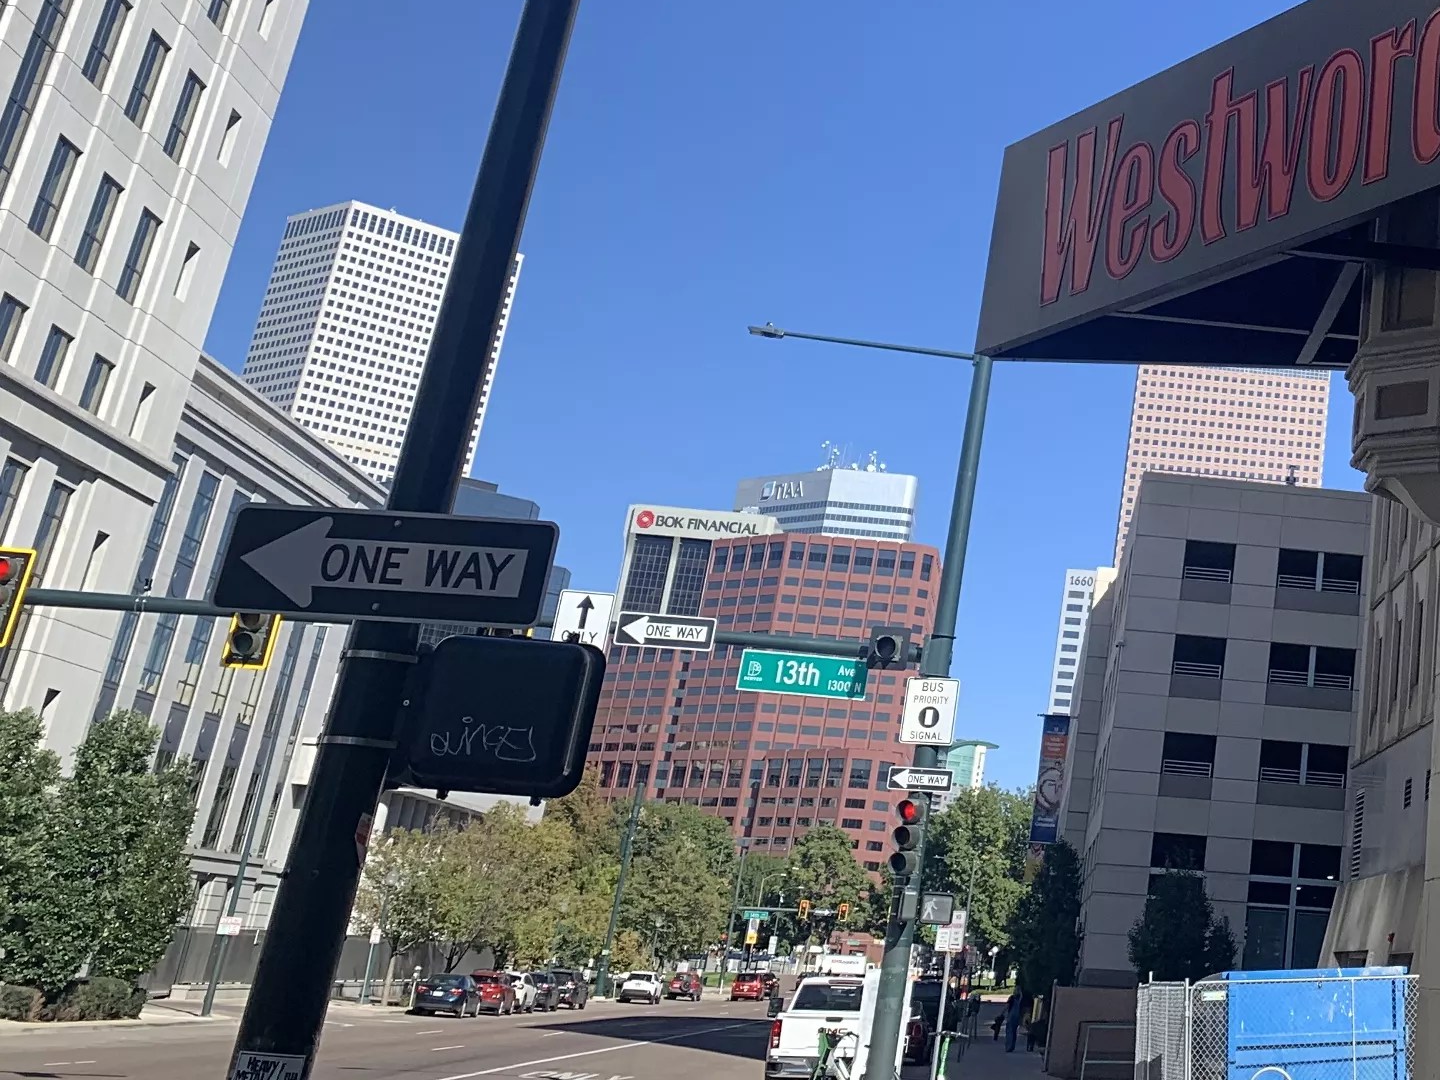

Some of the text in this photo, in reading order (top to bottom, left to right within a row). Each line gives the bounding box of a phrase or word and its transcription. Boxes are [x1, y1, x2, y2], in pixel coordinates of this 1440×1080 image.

[775, 480, 803, 500] TIAA
[655, 515, 759, 535] BOK FINANCIAL
[321, 543, 515, 590] ONE WAY
[1070, 576, 1094, 587] 1660
[561, 630, 598, 644] OLY
[646, 624, 703, 640] ONE WAY
[775, 659, 856, 687] 13th Ave
[827, 679, 862, 693] 1300 N
[921, 681, 944, 693] BUS
[913, 694, 950, 705] PRIORITY
[909, 730, 943, 741] SIGNAL
[907, 774, 946, 785] ONE WAY
